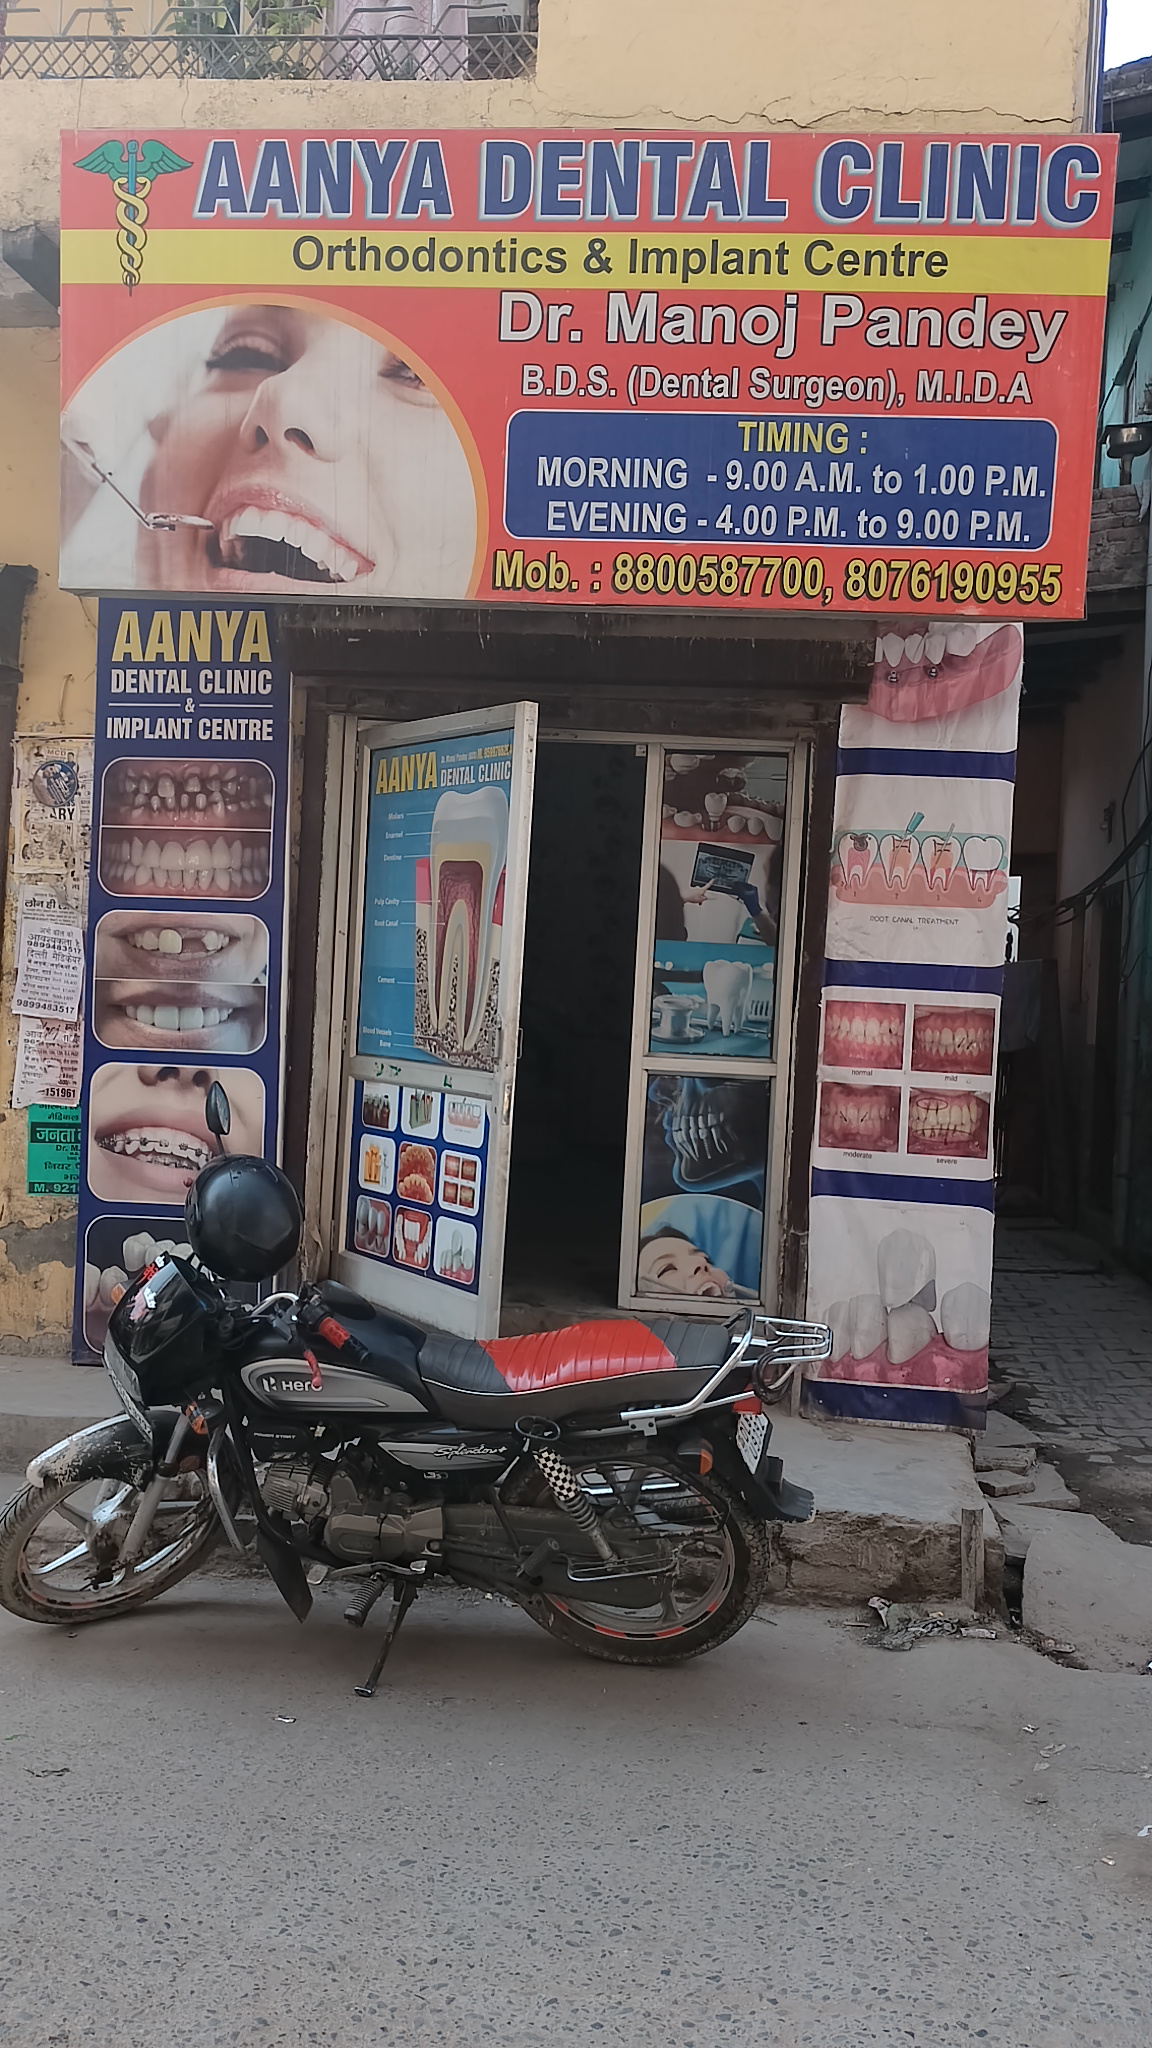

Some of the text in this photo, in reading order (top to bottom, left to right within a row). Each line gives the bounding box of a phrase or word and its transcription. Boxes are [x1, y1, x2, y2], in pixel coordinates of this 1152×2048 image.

[193, 138, 1102, 229] AANYA DENTAL CLINIC
[292, 235, 949, 284] Orthodontics & Implant Centre
[498, 289, 1069, 363] Dr. Manoj Pandey
[521, 364, 1032, 410] B.D.S. (Dental Surgeon), M.I.D.A
[738, 421, 849, 454] TIMING
[536, 456, 688, 490] MORNING
[725, 459, 788, 492] 9.00
[794, 461, 862, 494] A.M.
[872, 463, 903, 495] to
[914, 463, 975, 495] 1.00
[985, 465, 1046, 498] P.M.
[547, 500, 688, 535] EVENING
[715, 504, 778, 536] 4.00
[787, 505, 848, 538] P.M.
[857, 508, 888, 540] to
[897, 508, 960, 540] 9.00
[969, 510, 1031, 543] P.M.
[493, 549, 580, 592] Mob.
[612, 552, 834, 605] 8800587700,
[844, 557, 1064, 605] 8076190955
[111, 610, 273, 663] AANYA
[110, 668, 273, 695] DENTAL CLINIC
[184, 697, 195, 713] &
[106, 716, 274, 741] IMPLANT CENTRE
[375, 751, 511, 795] AANYA DENTAL CLINIC
[385, 831, 404, 839] Enamel
[383, 854, 402, 862] Dentine
[870, 915, 959, 925] ROOT CANAL TREATMENT
[377, 975, 396, 984] Cement
[16, 998, 75, 1014] 9899483517
[36, 1127, 76, 1143] जनता
[55, 1144, 68, 1152] Dr.
[843, 1150, 873, 1160] moderate
